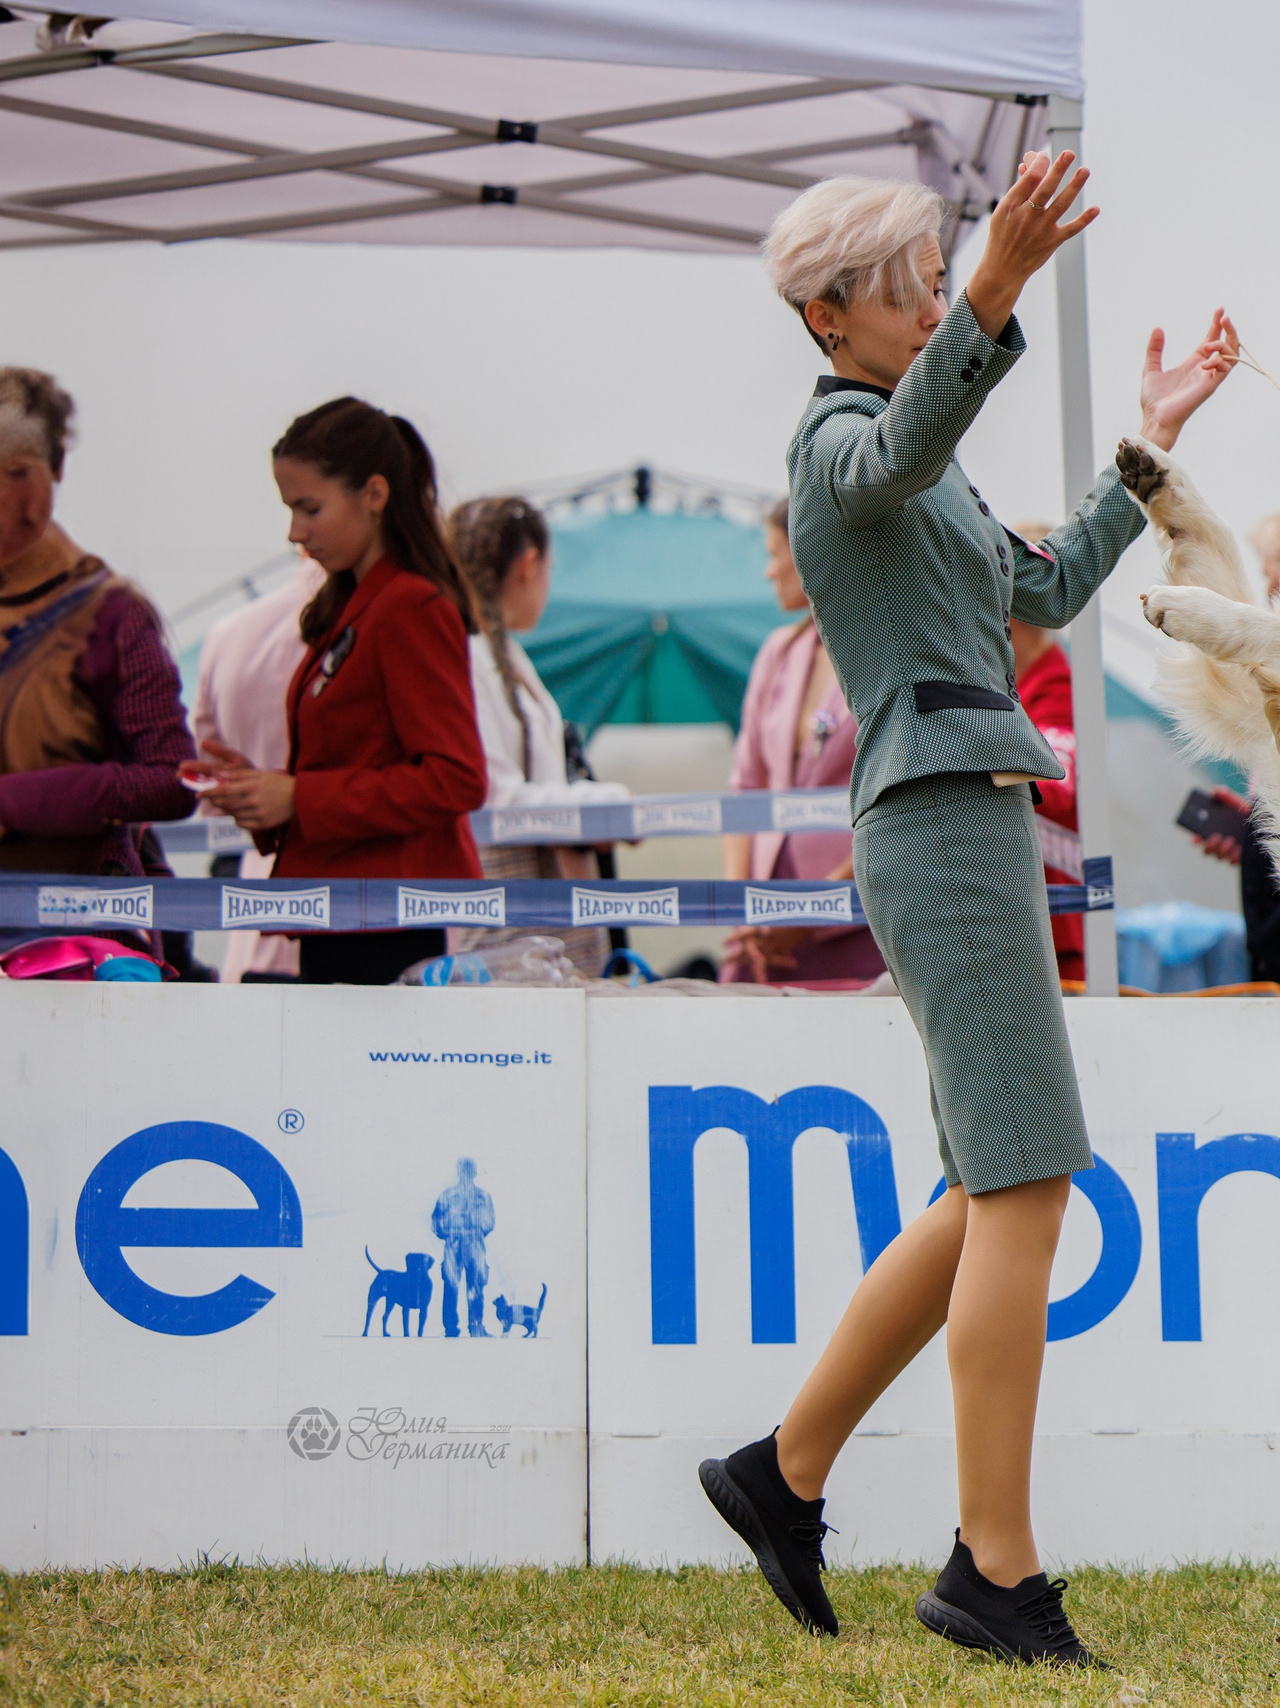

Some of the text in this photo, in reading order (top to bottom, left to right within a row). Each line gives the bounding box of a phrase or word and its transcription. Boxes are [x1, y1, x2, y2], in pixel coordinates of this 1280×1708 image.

[112, 894, 147, 918] DOG
[228, 895, 324, 919] HAPPY DOG
[404, 896, 499, 918] HAPPY DOG
[578, 897, 673, 918] HAPPY DOG
[751, 896, 845, 915] HAPPY DOG
[368, 1050, 552, 1067] www.monge.it
